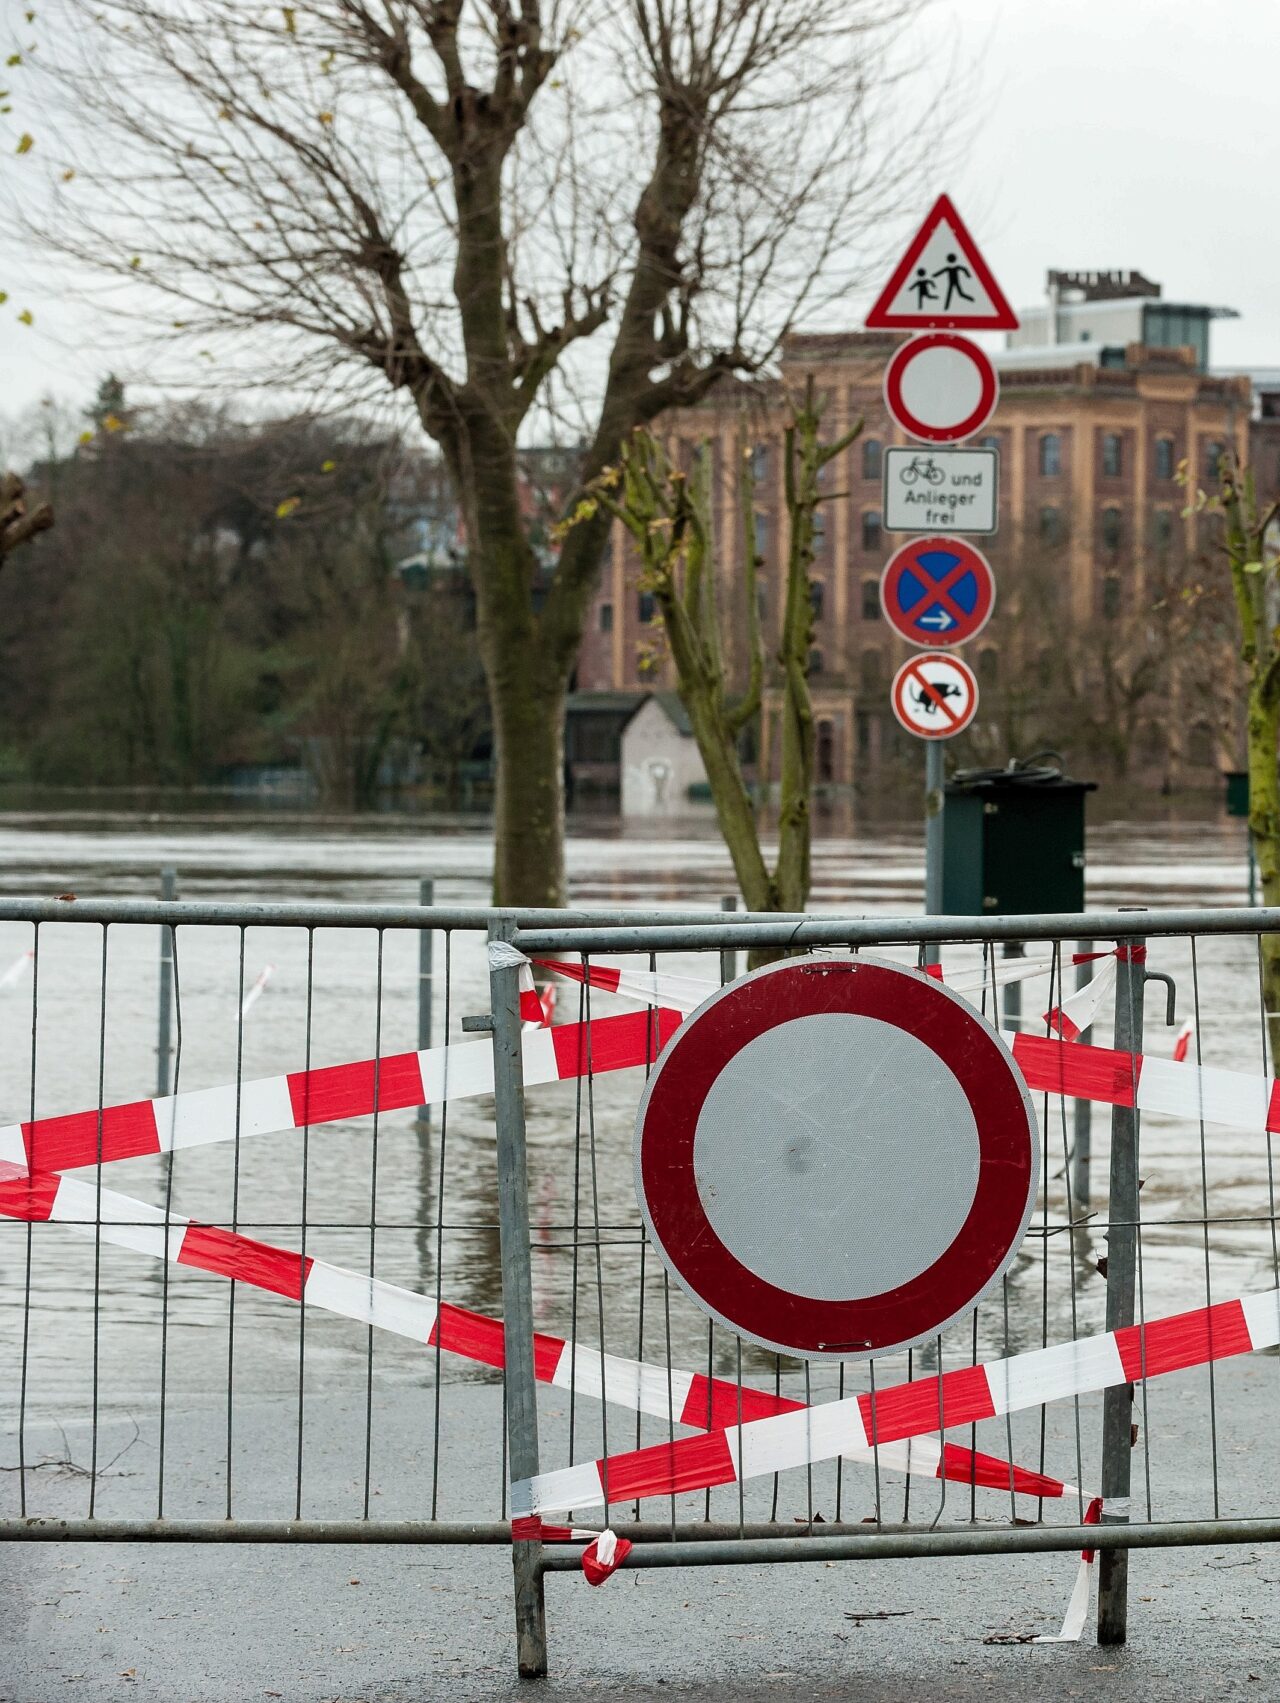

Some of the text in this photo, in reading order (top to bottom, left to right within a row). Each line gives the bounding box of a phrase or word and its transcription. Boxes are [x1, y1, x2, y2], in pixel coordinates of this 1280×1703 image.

[952, 472, 982, 486] und
[905, 491, 976, 509] Anlieger
[926, 510, 955, 524] frei
